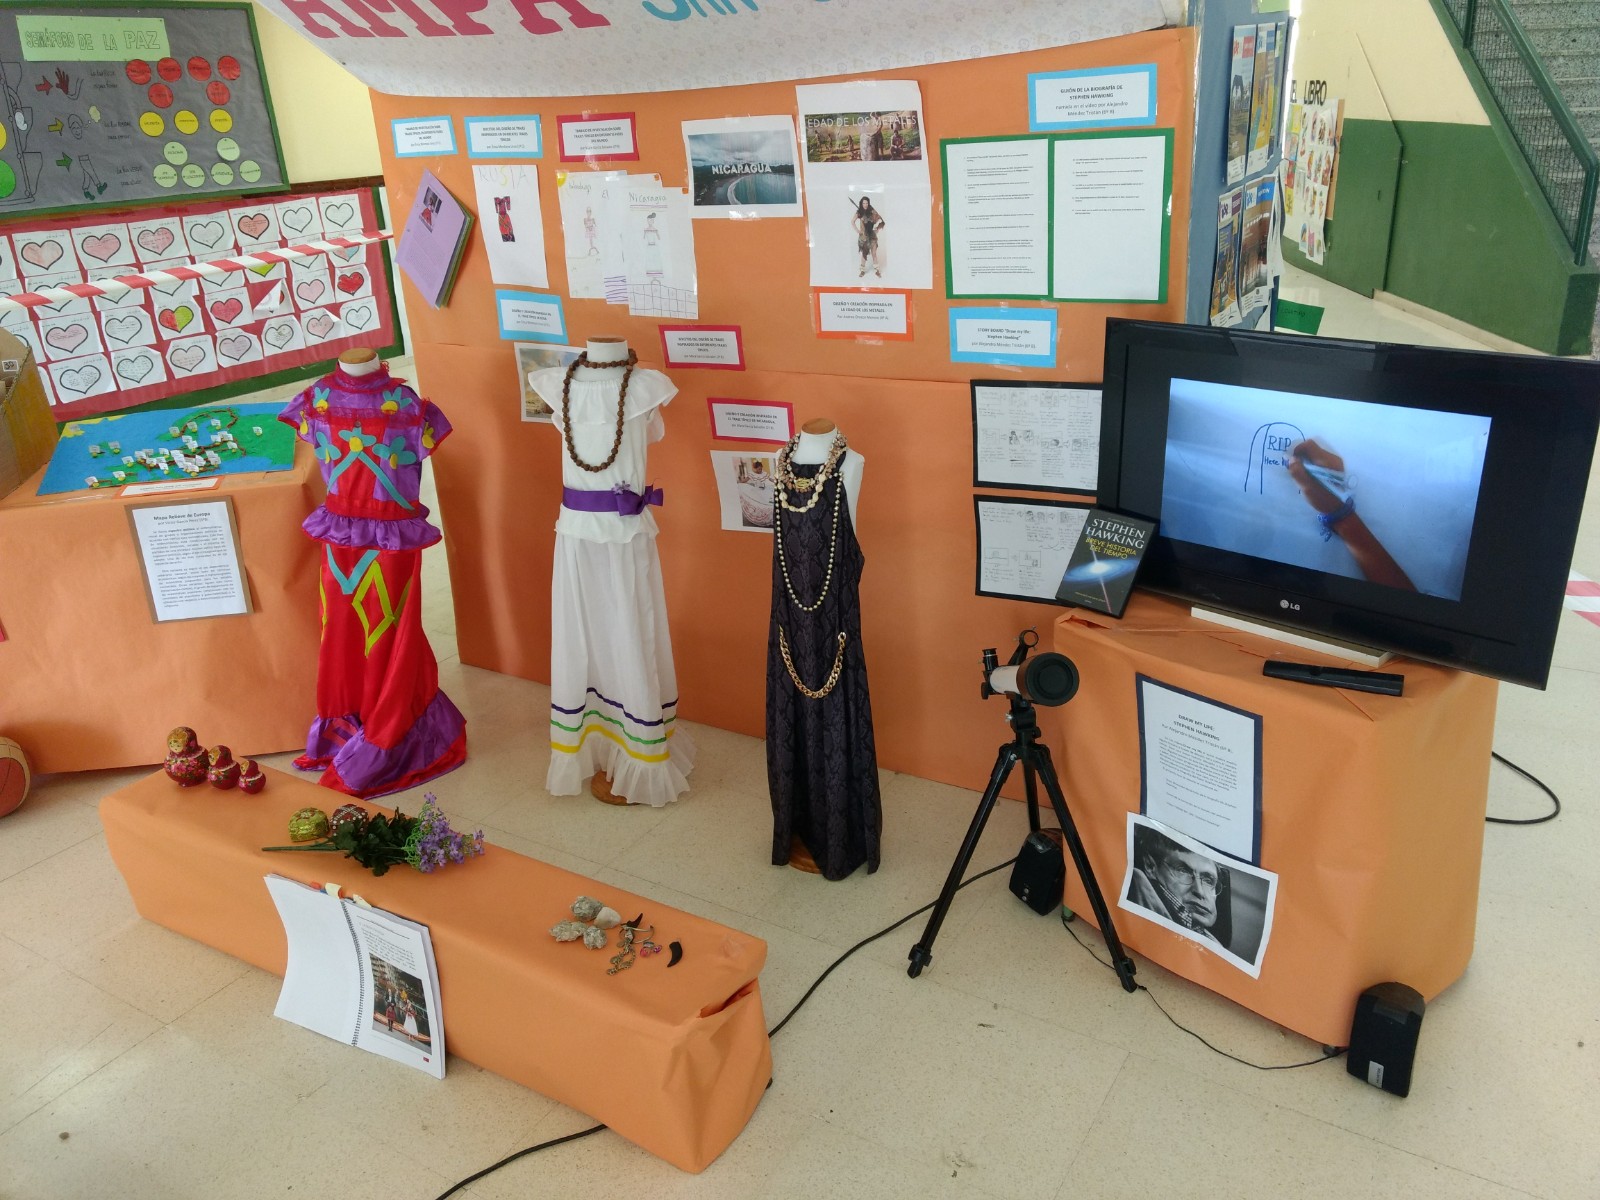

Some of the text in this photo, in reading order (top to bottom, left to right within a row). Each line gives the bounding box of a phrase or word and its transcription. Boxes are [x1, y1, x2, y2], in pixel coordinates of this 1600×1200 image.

[26, 28, 160, 50] SEMÁFORO DE LA PAZ
[1304, 80, 1327, 106] LIBRO
[808, 114, 917, 128] EDAD DE LOS METALES
[712, 163, 772, 174] NICARAGUA
[1267, 436, 1292, 452] RIP
[1086, 526, 1144, 549] HAWKING
[1092, 518, 1146, 540] STEPHEN
[1086, 536, 1136, 556] BREVE HISTORIA
[1090, 544, 1128, 560] DEL TIEMPO
[1290, 602, 1300, 610] LG
[1178, 714, 1194, 724] DRAW
[1173, 721, 1220, 741] STEPHEN HAWKING
